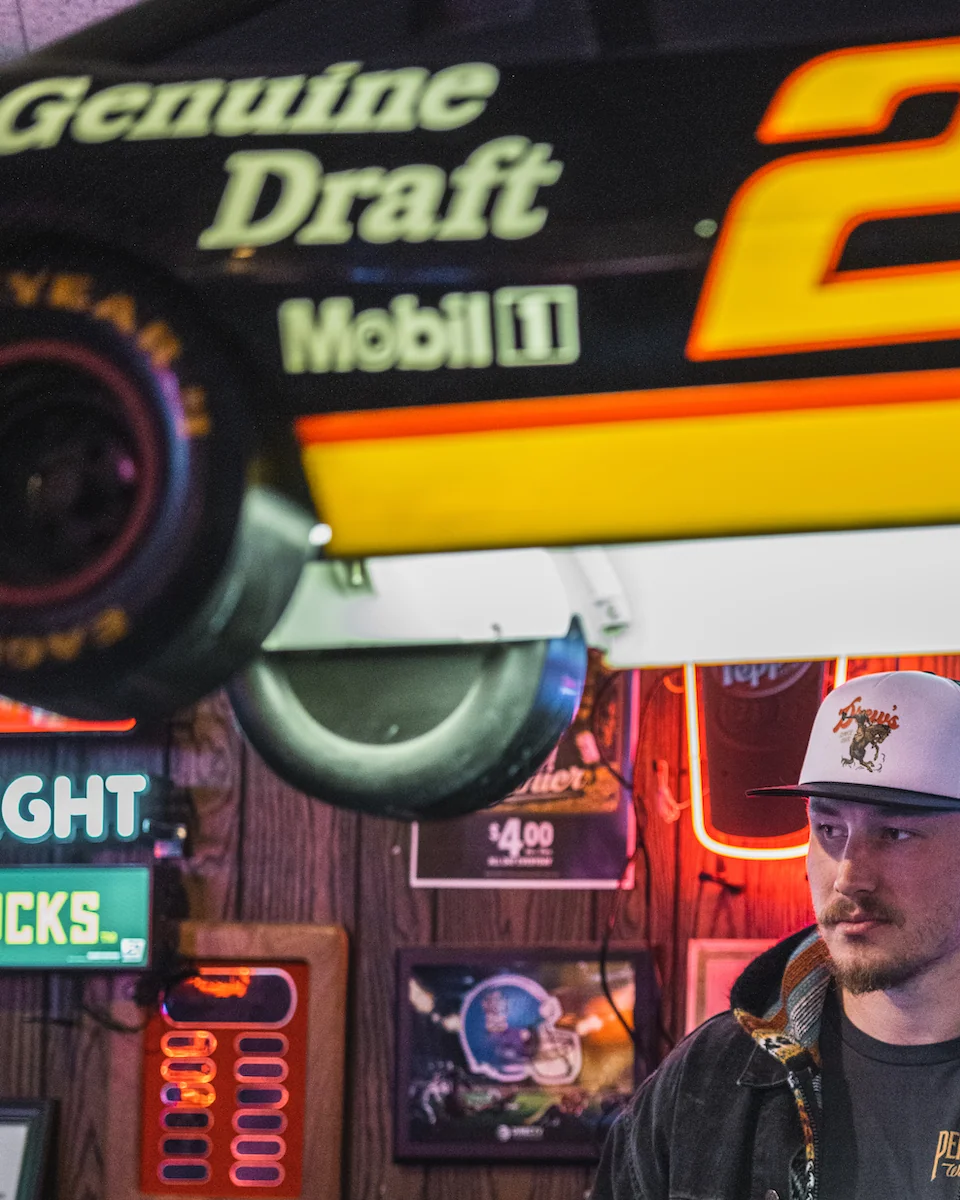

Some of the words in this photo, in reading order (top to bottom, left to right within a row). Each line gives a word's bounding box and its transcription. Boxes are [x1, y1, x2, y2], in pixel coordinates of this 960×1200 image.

[0, 61, 500, 155] Genuine
[197, 135, 564, 249] Draft
[278, 292, 495, 374] Mobil
[2, 775, 147, 839] GHT
[0, 890, 101, 945] CKS
